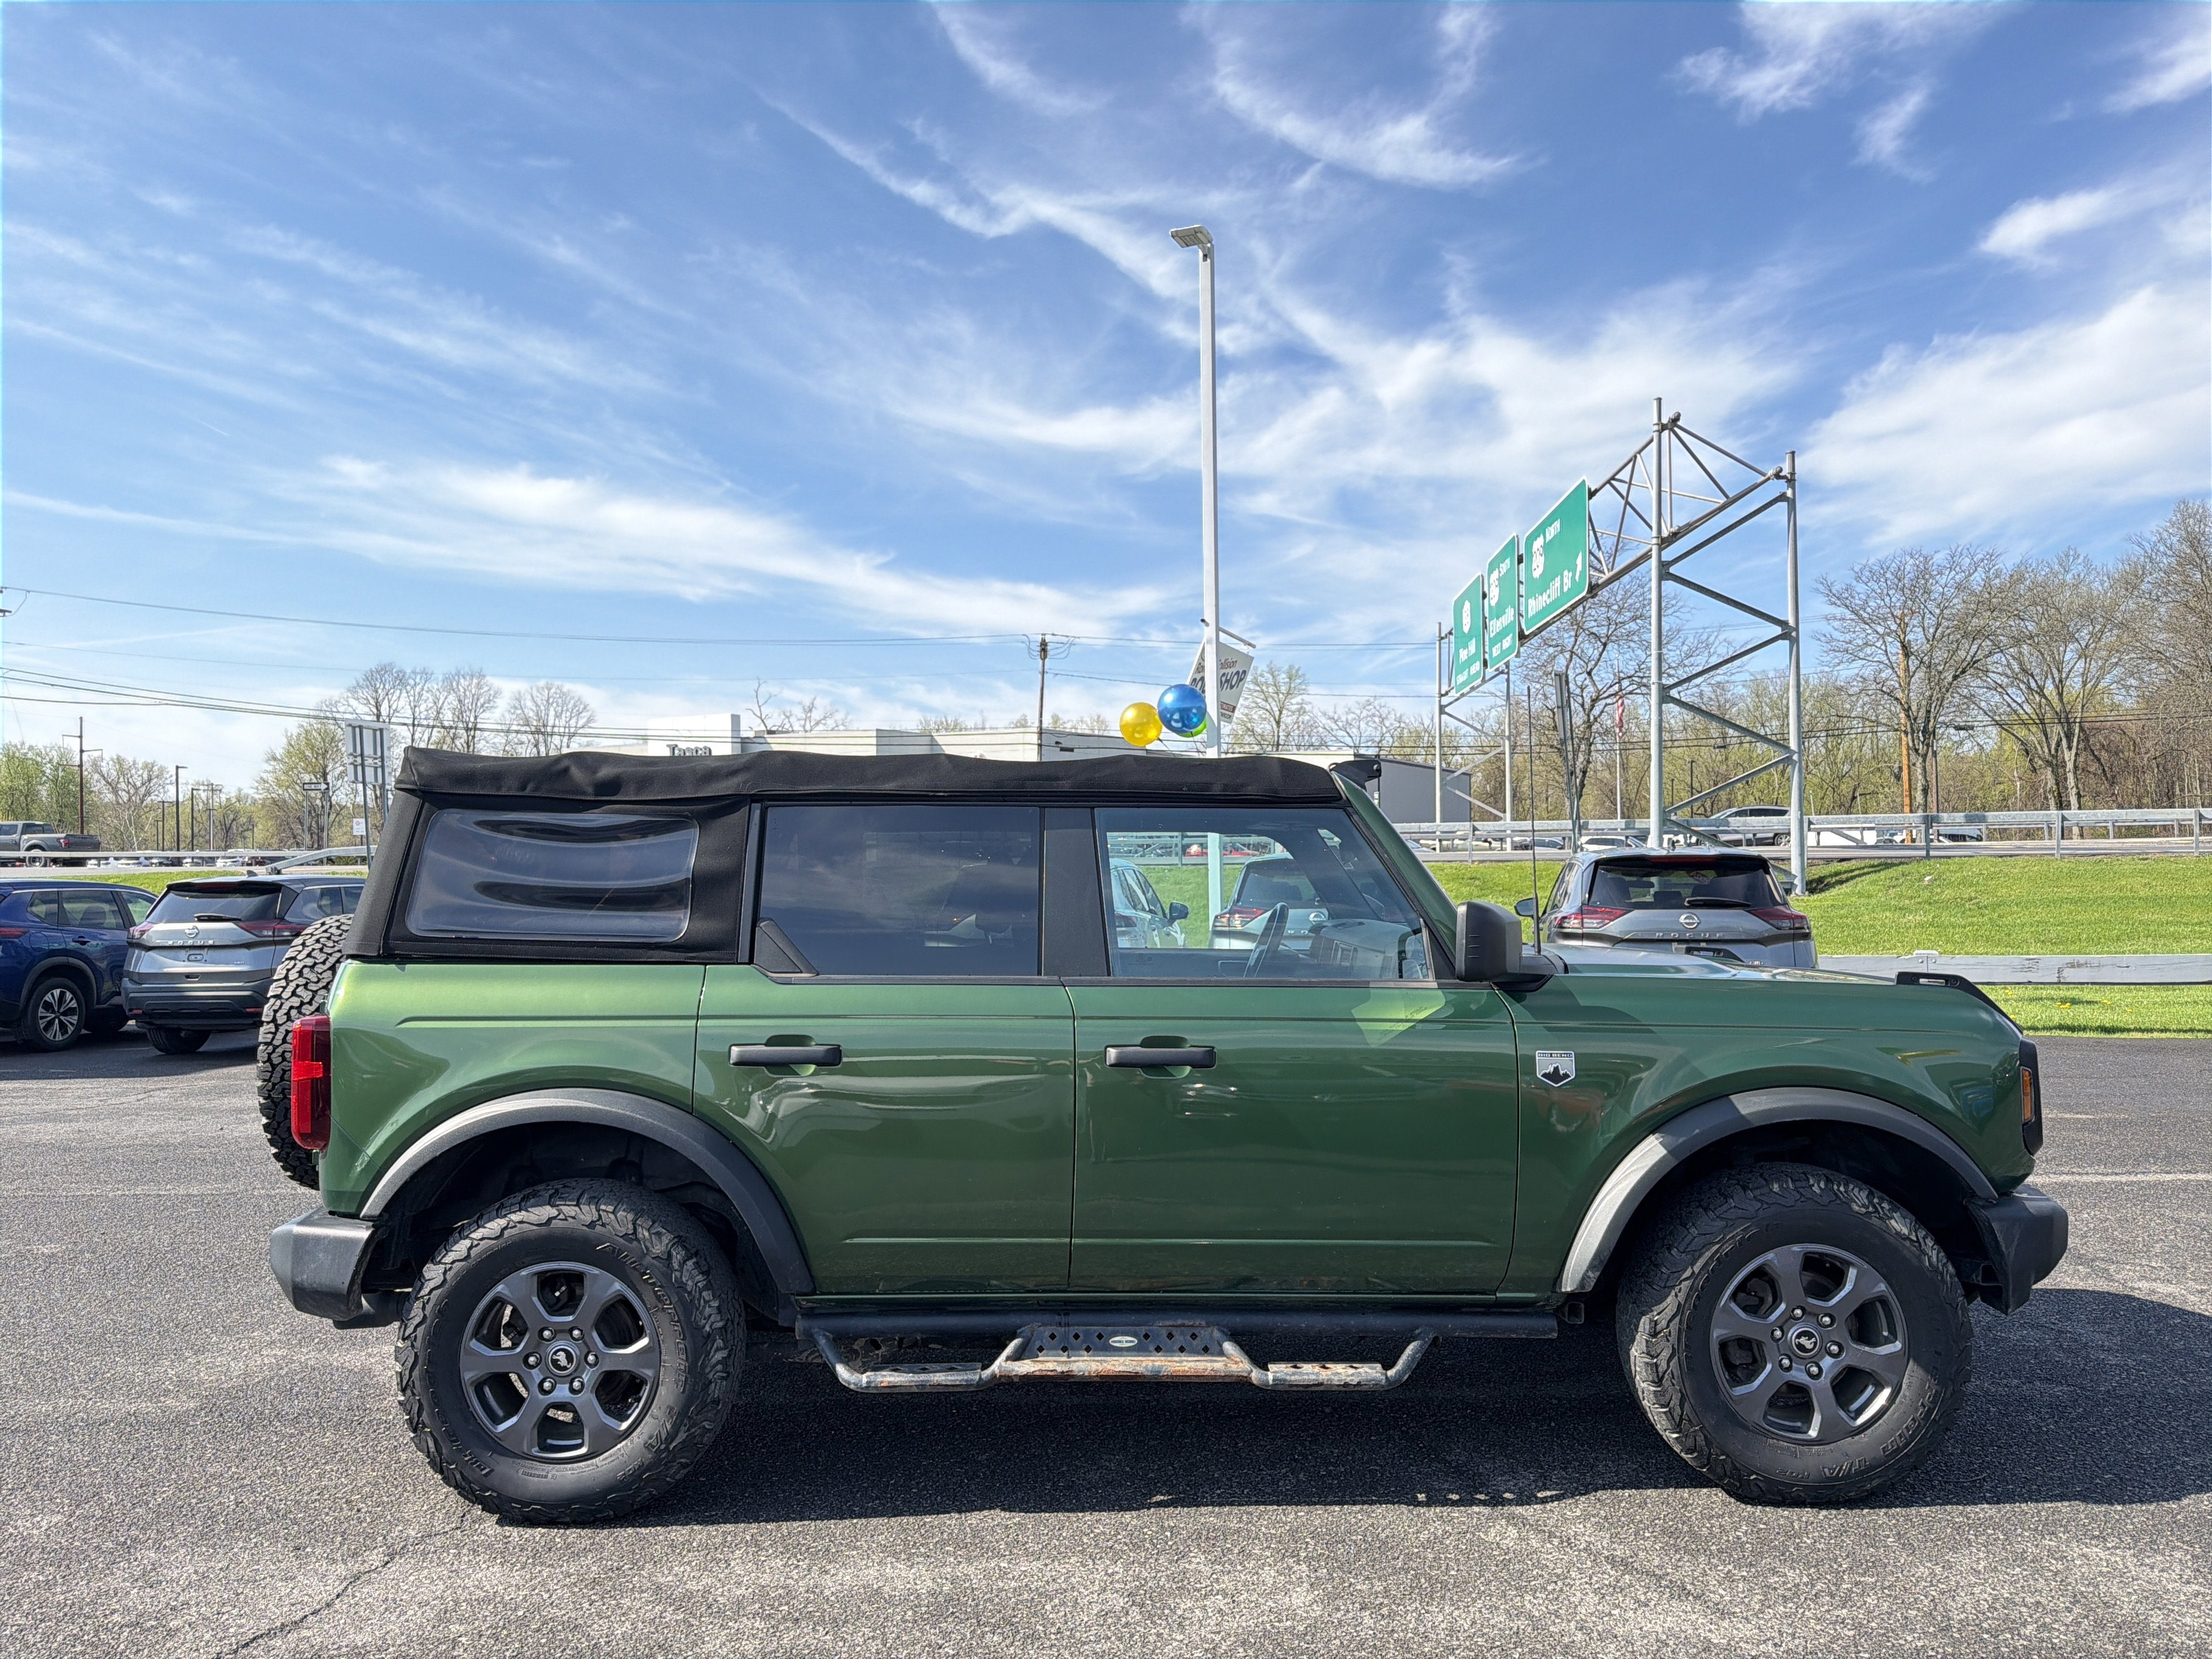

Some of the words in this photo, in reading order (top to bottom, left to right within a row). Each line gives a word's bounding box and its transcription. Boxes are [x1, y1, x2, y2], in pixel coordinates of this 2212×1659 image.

[1528, 575, 1561, 618] Rhinecliff
[1563, 569, 1572, 592] Br
[1220, 657, 1238, 670] ollision
[1220, 669, 1247, 692] SHOP
[666, 744, 712, 756] Tasca
